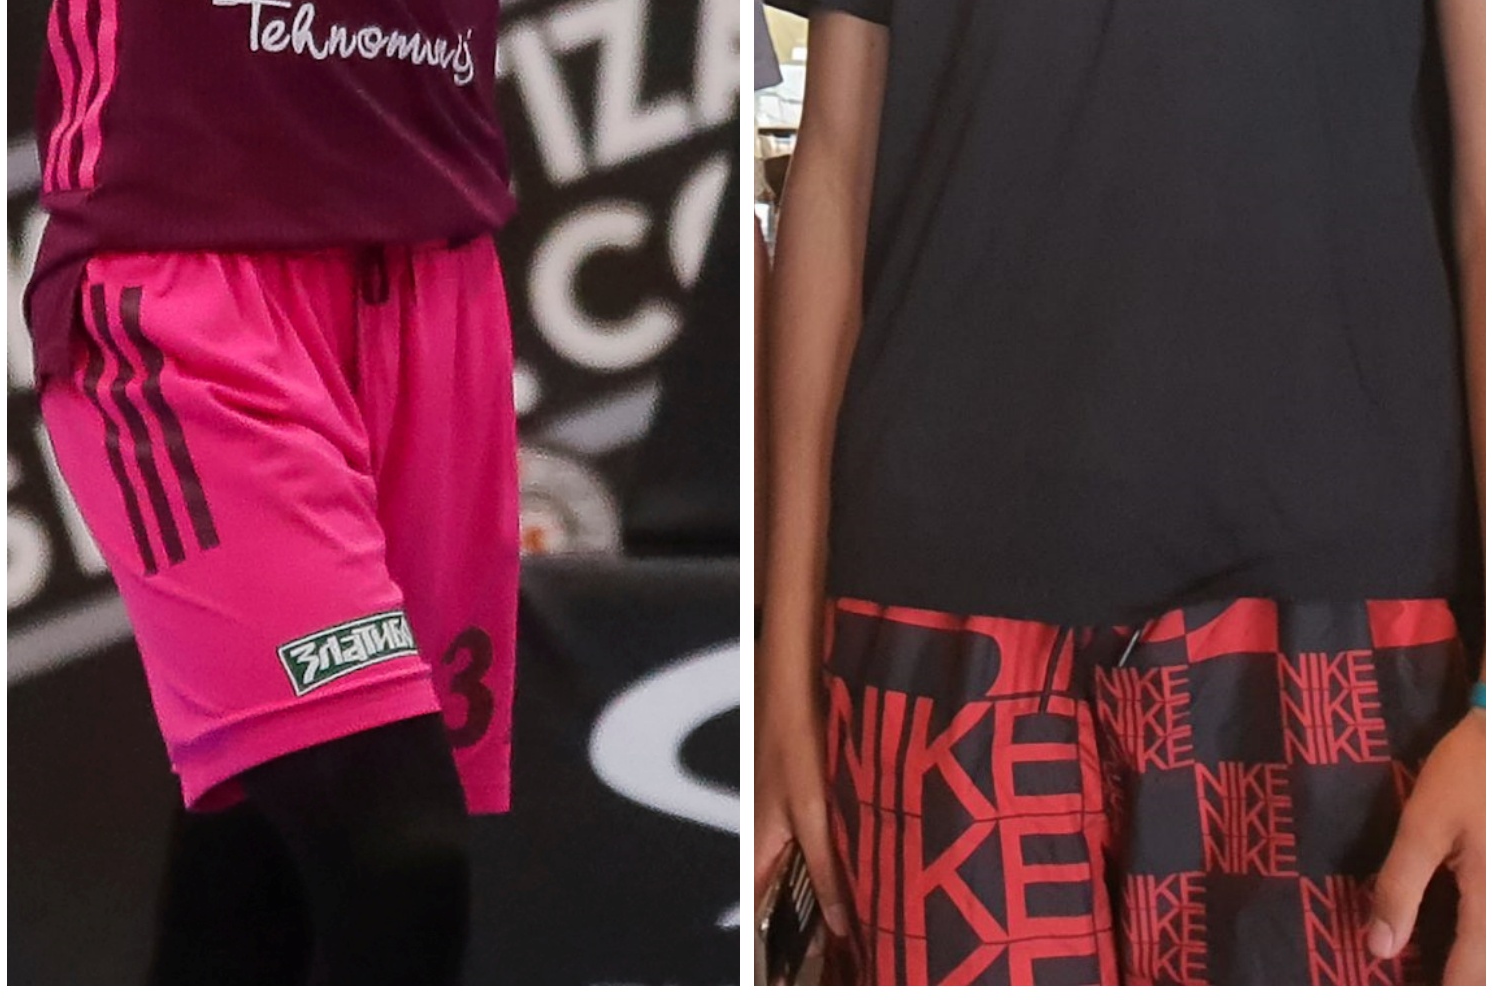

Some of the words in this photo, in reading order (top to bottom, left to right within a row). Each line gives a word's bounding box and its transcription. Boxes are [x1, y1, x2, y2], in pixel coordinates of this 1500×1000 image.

[444, 625, 494, 749] 3
[1096, 664, 1191, 701] NIKE
[1278, 650, 1378, 689] NIKE
[1098, 697, 1193, 736] NIKE
[1281, 686, 1385, 727] NIKE
[824, 676, 1083, 820] NIKE
[1284, 722, 1392, 765] NIKE
[1194, 761, 1291, 801] NIKE
[1199, 798, 1296, 838] NIKE
[1203, 835, 1300, 875] NIKE
